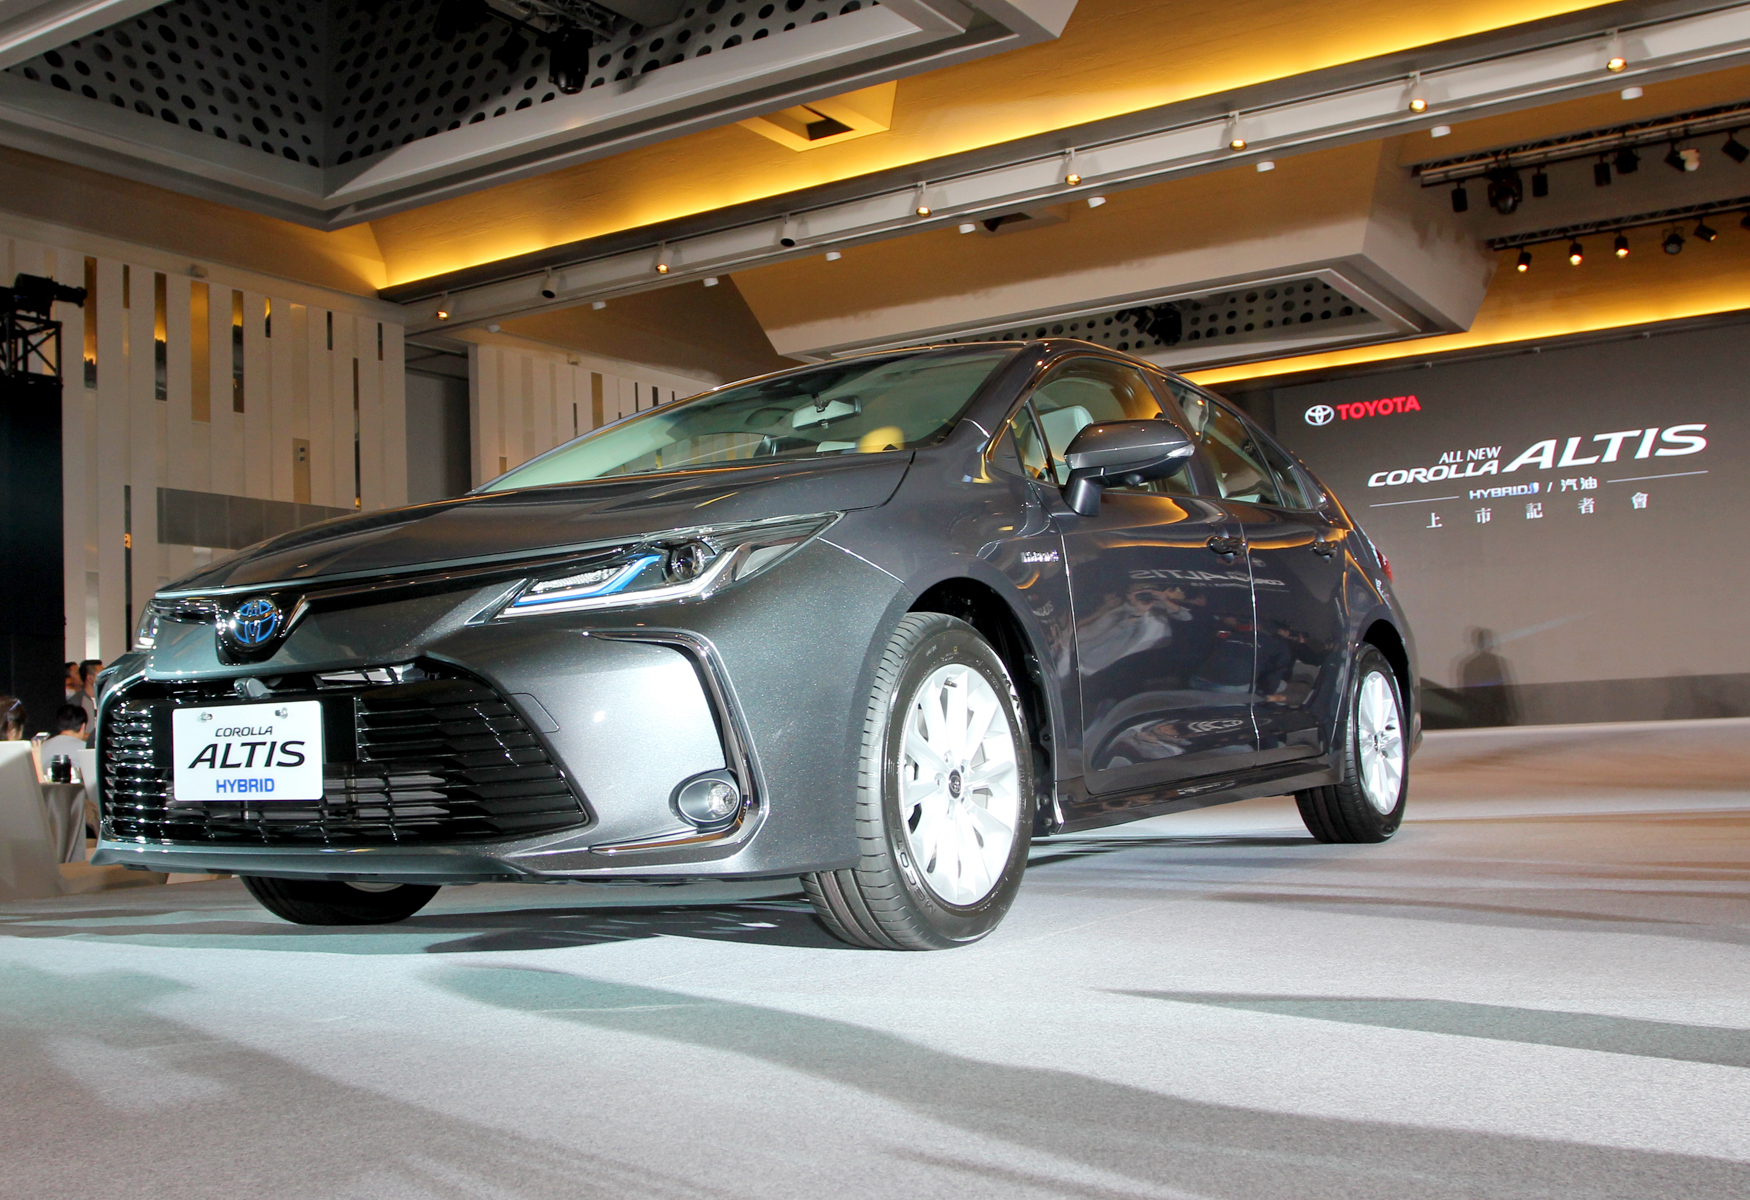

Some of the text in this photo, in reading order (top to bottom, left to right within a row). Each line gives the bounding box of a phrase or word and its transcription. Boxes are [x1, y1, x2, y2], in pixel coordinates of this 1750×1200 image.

[1336, 395, 1421, 420] TOYOTA
[1367, 424, 1708, 487] COROLLA ALTIS
[1438, 446, 1502, 464] ALL NEW
[1469, 484, 1529, 500] HYBRID
[1561, 476, 1598, 492] 汽油
[215, 726, 273, 738] COROLLA
[187, 740, 305, 769] ALTIS
[216, 778, 275, 793] HYBRID
